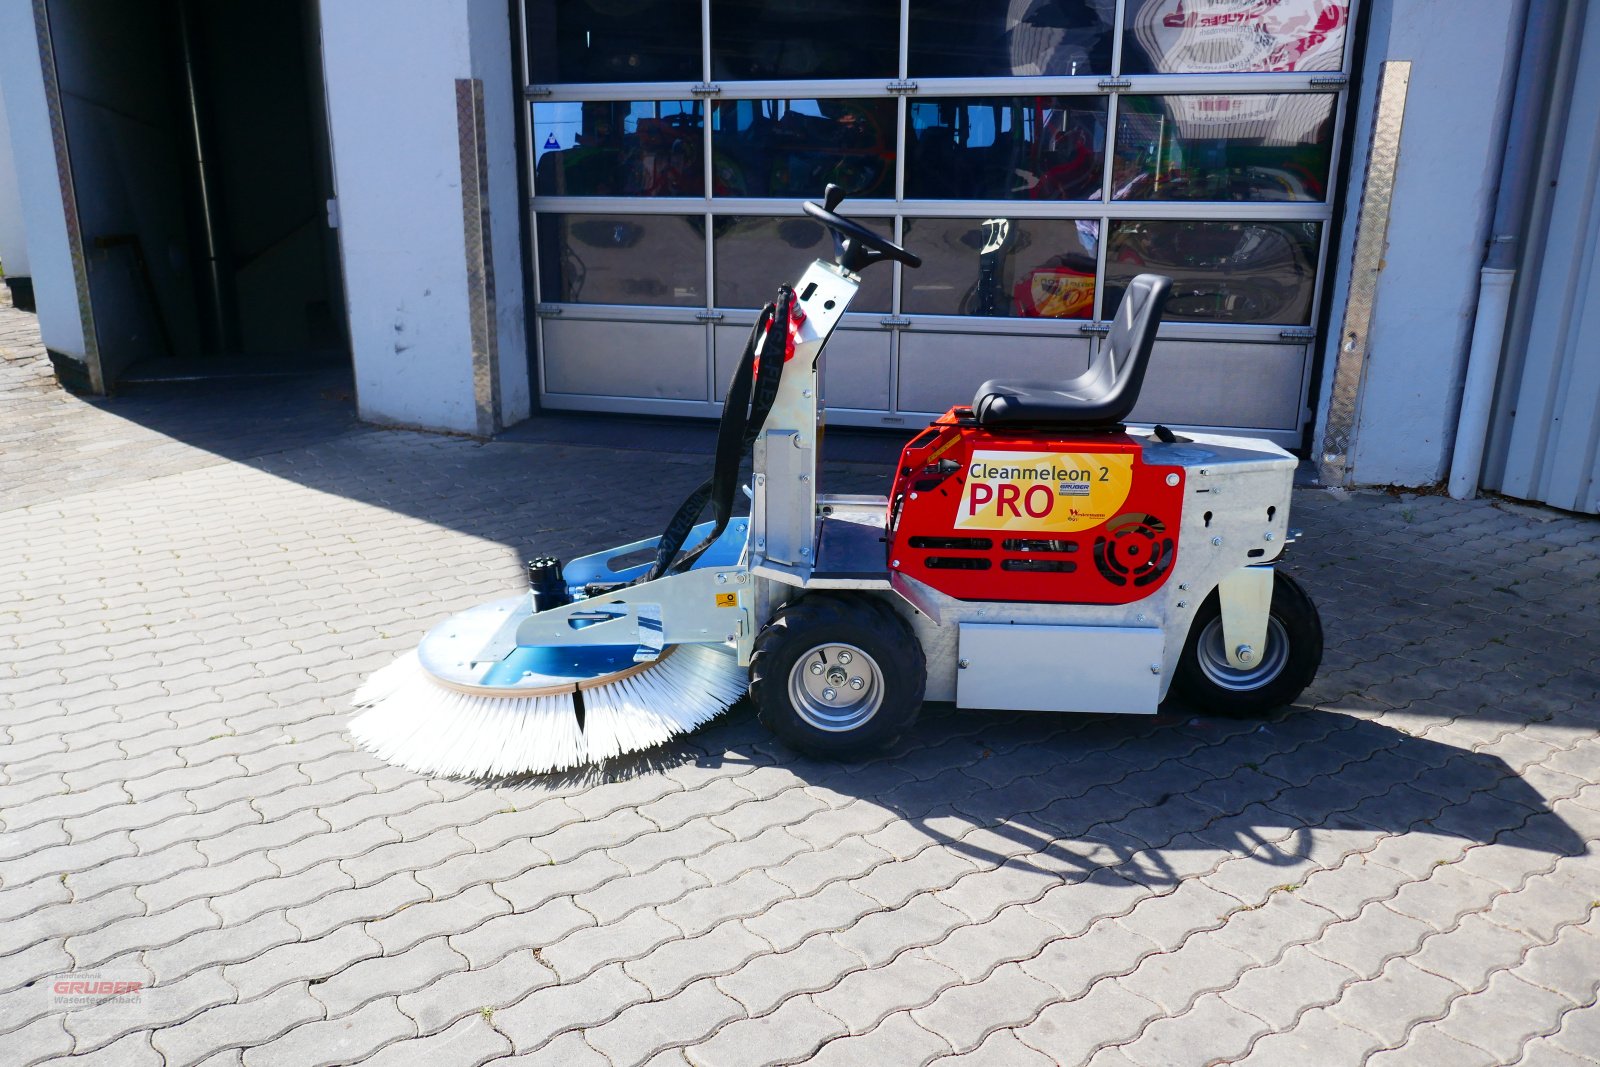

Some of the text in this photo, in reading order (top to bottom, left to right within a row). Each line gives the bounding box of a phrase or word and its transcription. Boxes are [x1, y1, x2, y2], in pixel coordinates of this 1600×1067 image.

[970, 463, 1109, 482] Cleanmeleon 2
[969, 483, 1054, 518] PRO
